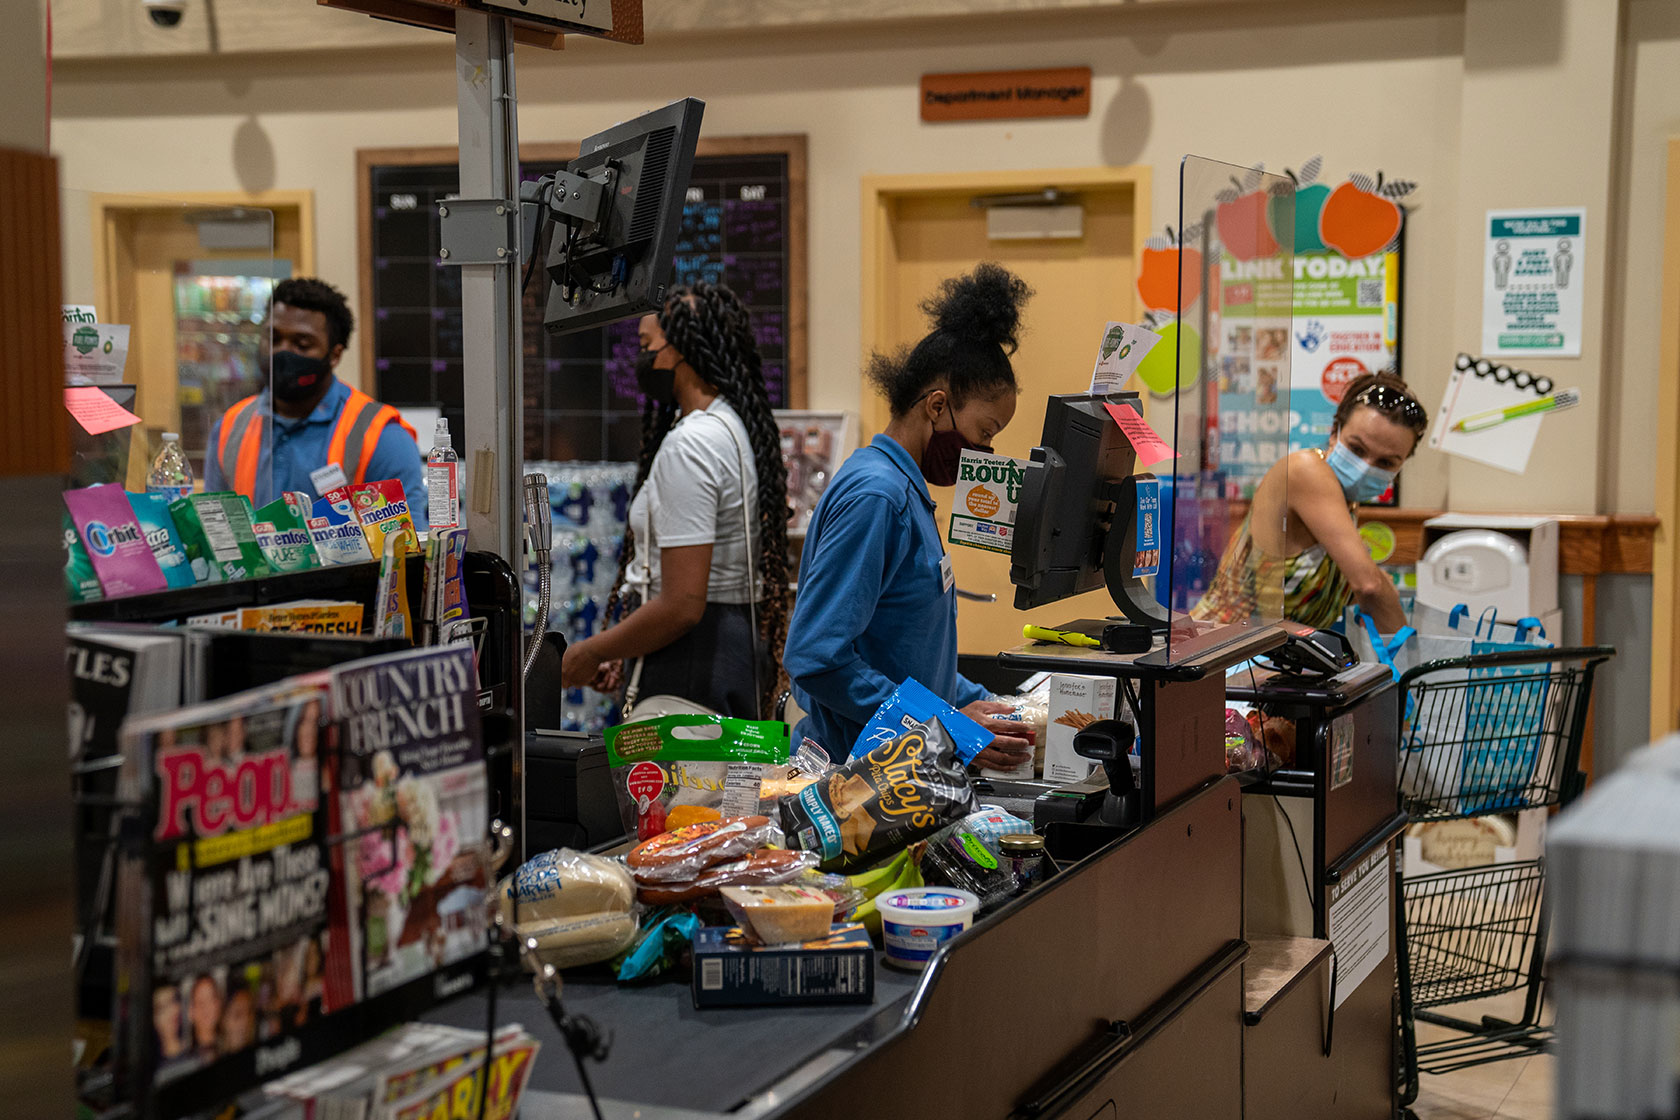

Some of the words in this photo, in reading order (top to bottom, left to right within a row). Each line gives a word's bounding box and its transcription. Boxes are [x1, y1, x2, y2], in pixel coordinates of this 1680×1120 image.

[960, 464, 1025, 485] ROUN
[327, 491, 340, 501] 50
[1006, 486, 1021, 504] U
[363, 501, 408, 524] mentos
[85, 520, 141, 556] Orbit
[256, 530, 309, 547] mentos
[312, 524, 362, 542] mentos
[350, 694, 465, 752] FRENCH
[867, 734, 936, 828] Stacy's
[869, 764, 883, 786] Pita
[877, 785, 895, 806] Chips
[803, 788, 822, 815] SIMPLY
[817, 814, 837, 844] NAKED
[506, 878, 562, 900] MARKET
[1331, 886, 1340, 901] TO
[1340, 870, 1359, 894] SERVE
[1358, 859, 1370, 878] YOU
